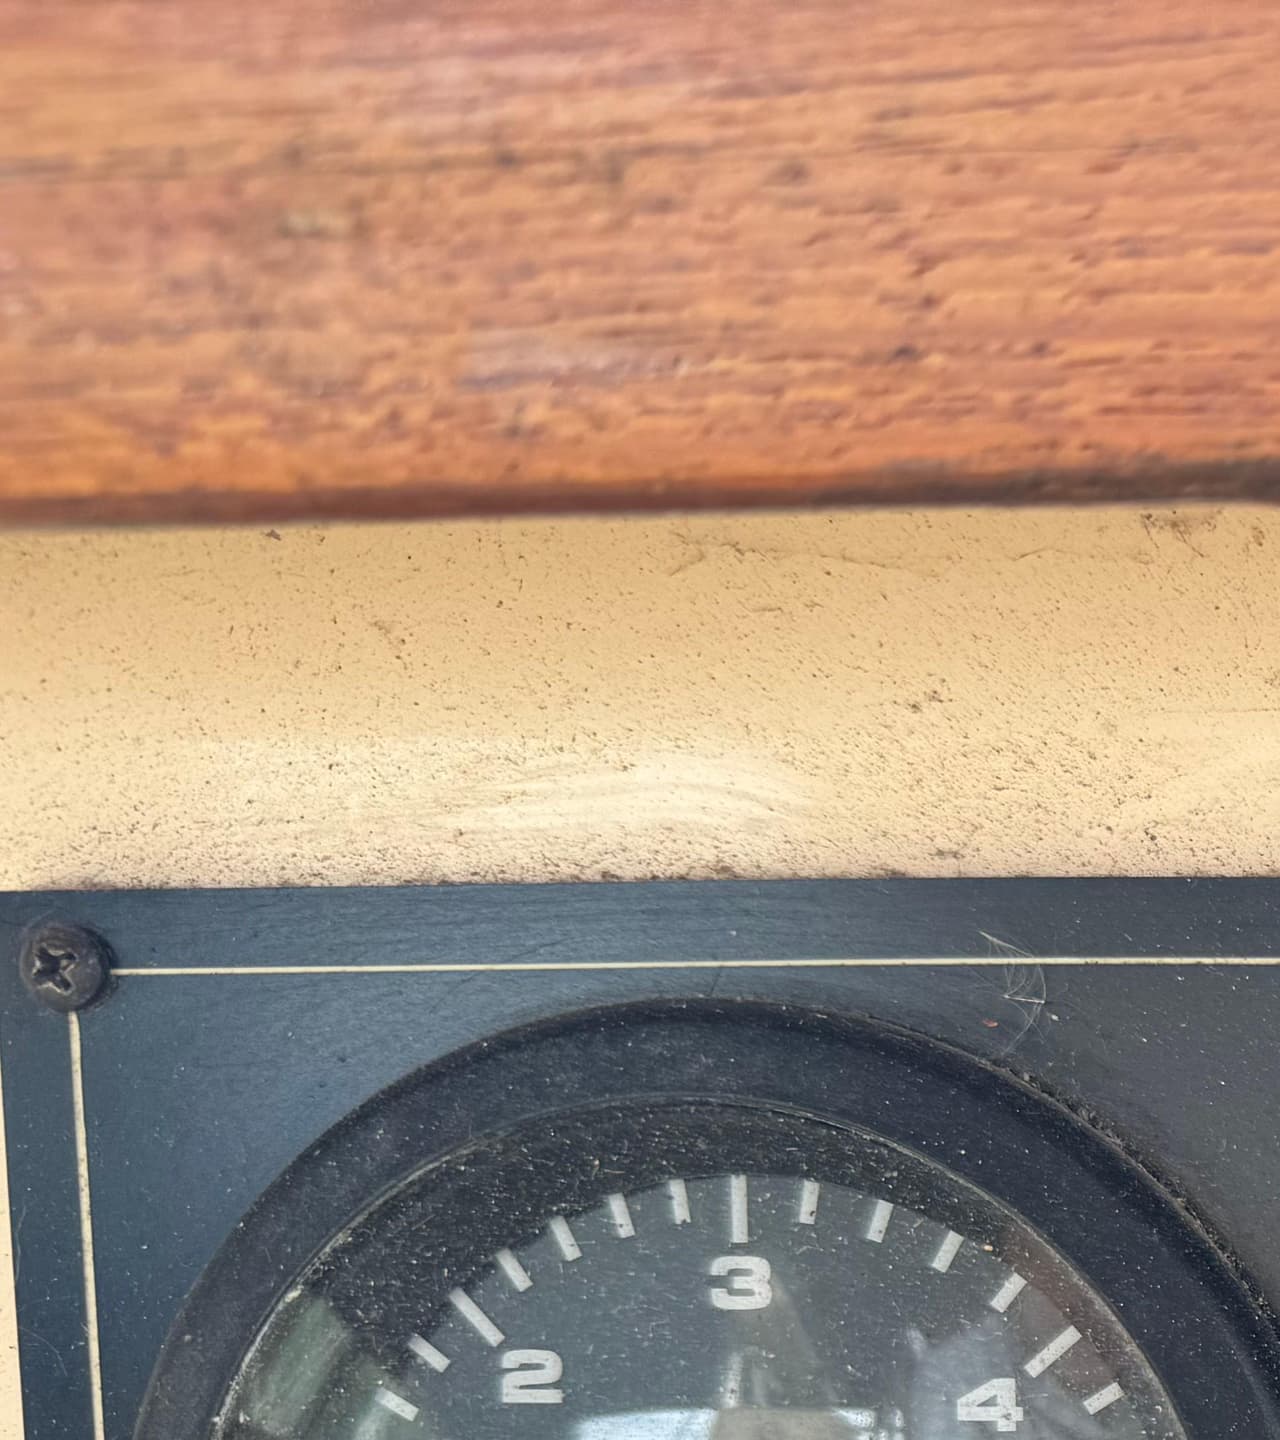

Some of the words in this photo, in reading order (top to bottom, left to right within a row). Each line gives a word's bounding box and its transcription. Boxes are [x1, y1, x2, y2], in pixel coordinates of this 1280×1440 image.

[708, 1255, 773, 1311] 3
[499, 1350, 565, 1404] 2
[956, 1377, 1024, 1432] 4
